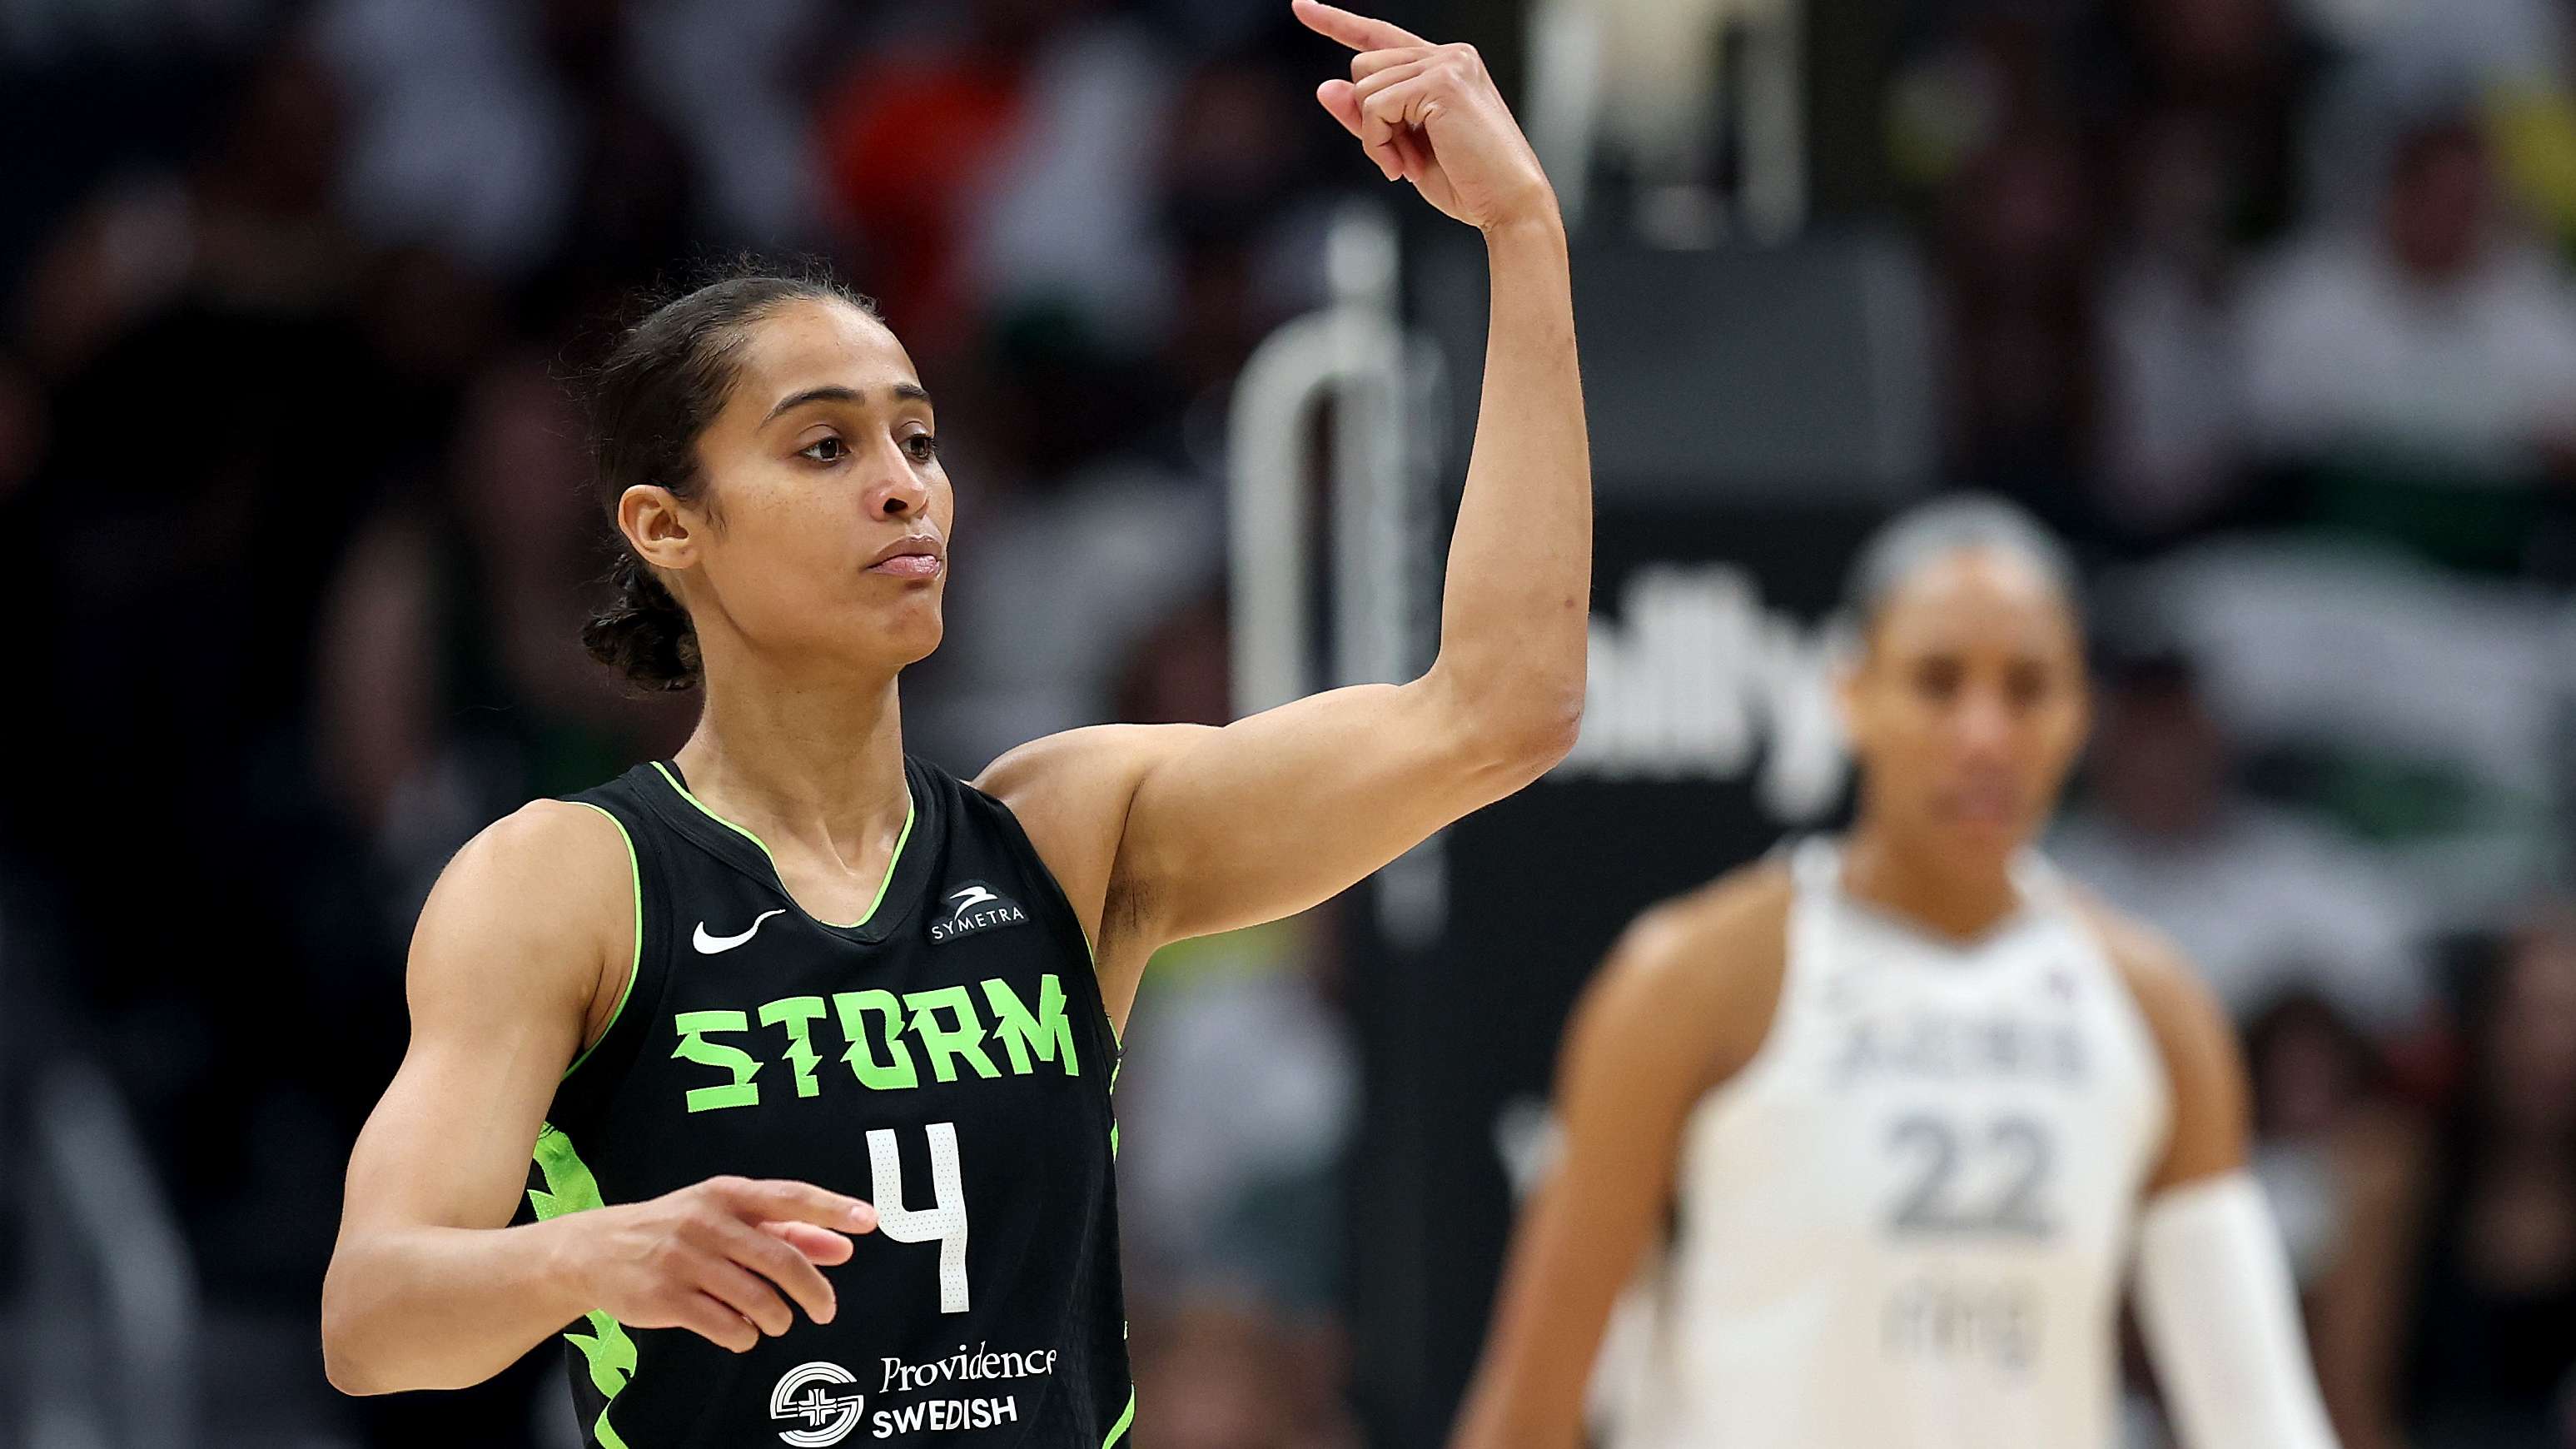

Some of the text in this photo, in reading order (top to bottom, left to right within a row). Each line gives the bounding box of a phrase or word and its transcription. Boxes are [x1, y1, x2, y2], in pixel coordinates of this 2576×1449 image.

[932, 906, 1024, 939] SYMETRA
[672, 973, 1079, 1113] STORM
[865, 1122, 970, 1314] 4
[1880, 1112, 2058, 1237] 22
[878, 1341, 1057, 1393] Providence
[872, 1395, 1017, 1439] SWEDISH
